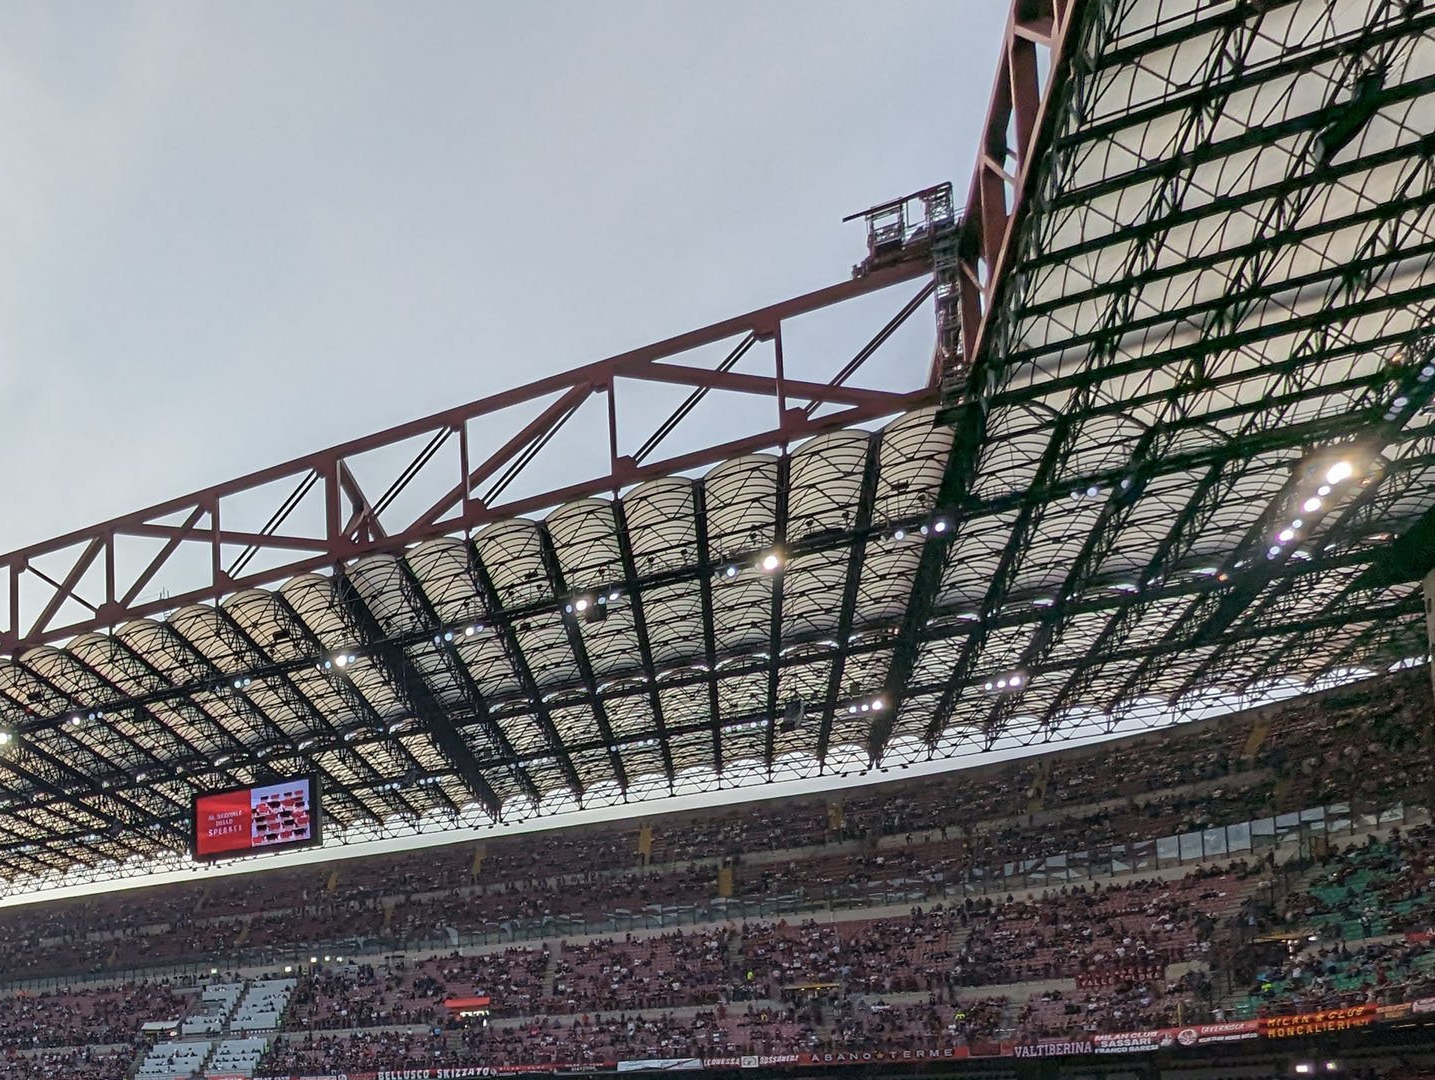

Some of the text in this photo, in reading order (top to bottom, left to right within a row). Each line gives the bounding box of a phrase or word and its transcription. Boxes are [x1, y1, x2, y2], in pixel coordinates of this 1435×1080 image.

[1268, 1020, 1351, 1038] MONCALIERI
[1094, 1032, 1129, 1041] MILAN
[1100, 1037, 1151, 1048] SASSARI
[811, 1048, 953, 1062] ABANO TERME
[1014, 1041, 1093, 1058] VALTIBERINA
[377, 1069, 430, 1080] BELLUSCO
[436, 1066, 490, 1079] SKIZZATO
